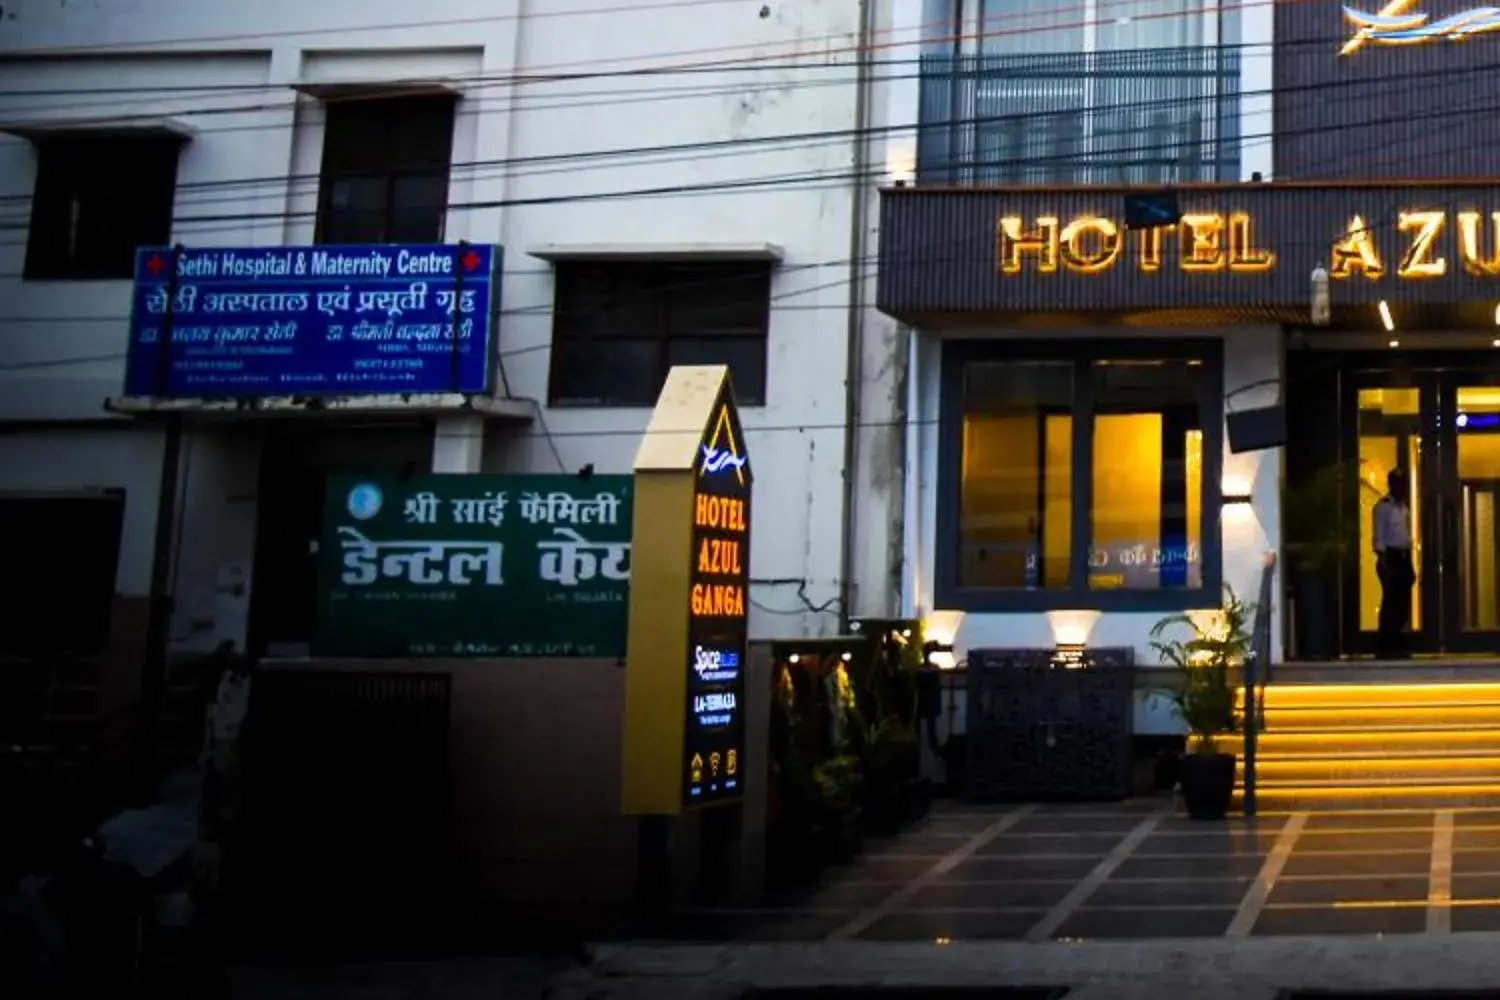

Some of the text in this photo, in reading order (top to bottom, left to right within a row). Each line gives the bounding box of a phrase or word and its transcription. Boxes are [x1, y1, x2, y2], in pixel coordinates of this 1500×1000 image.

[1000, 211, 1277, 275] HOTEL
[176, 248, 453, 280] Sethi Hospital & Maternity Centre
[202, 291, 312, 313] अस्पताल
[316, 285, 352, 317] एवं
[401, 490, 444, 525] श्री
[695, 493, 746, 531] HOTEL
[336, 525, 632, 587] डेन्टल केय
[697, 536, 741, 576] AZUL
[691, 582, 744, 617] GANGA
